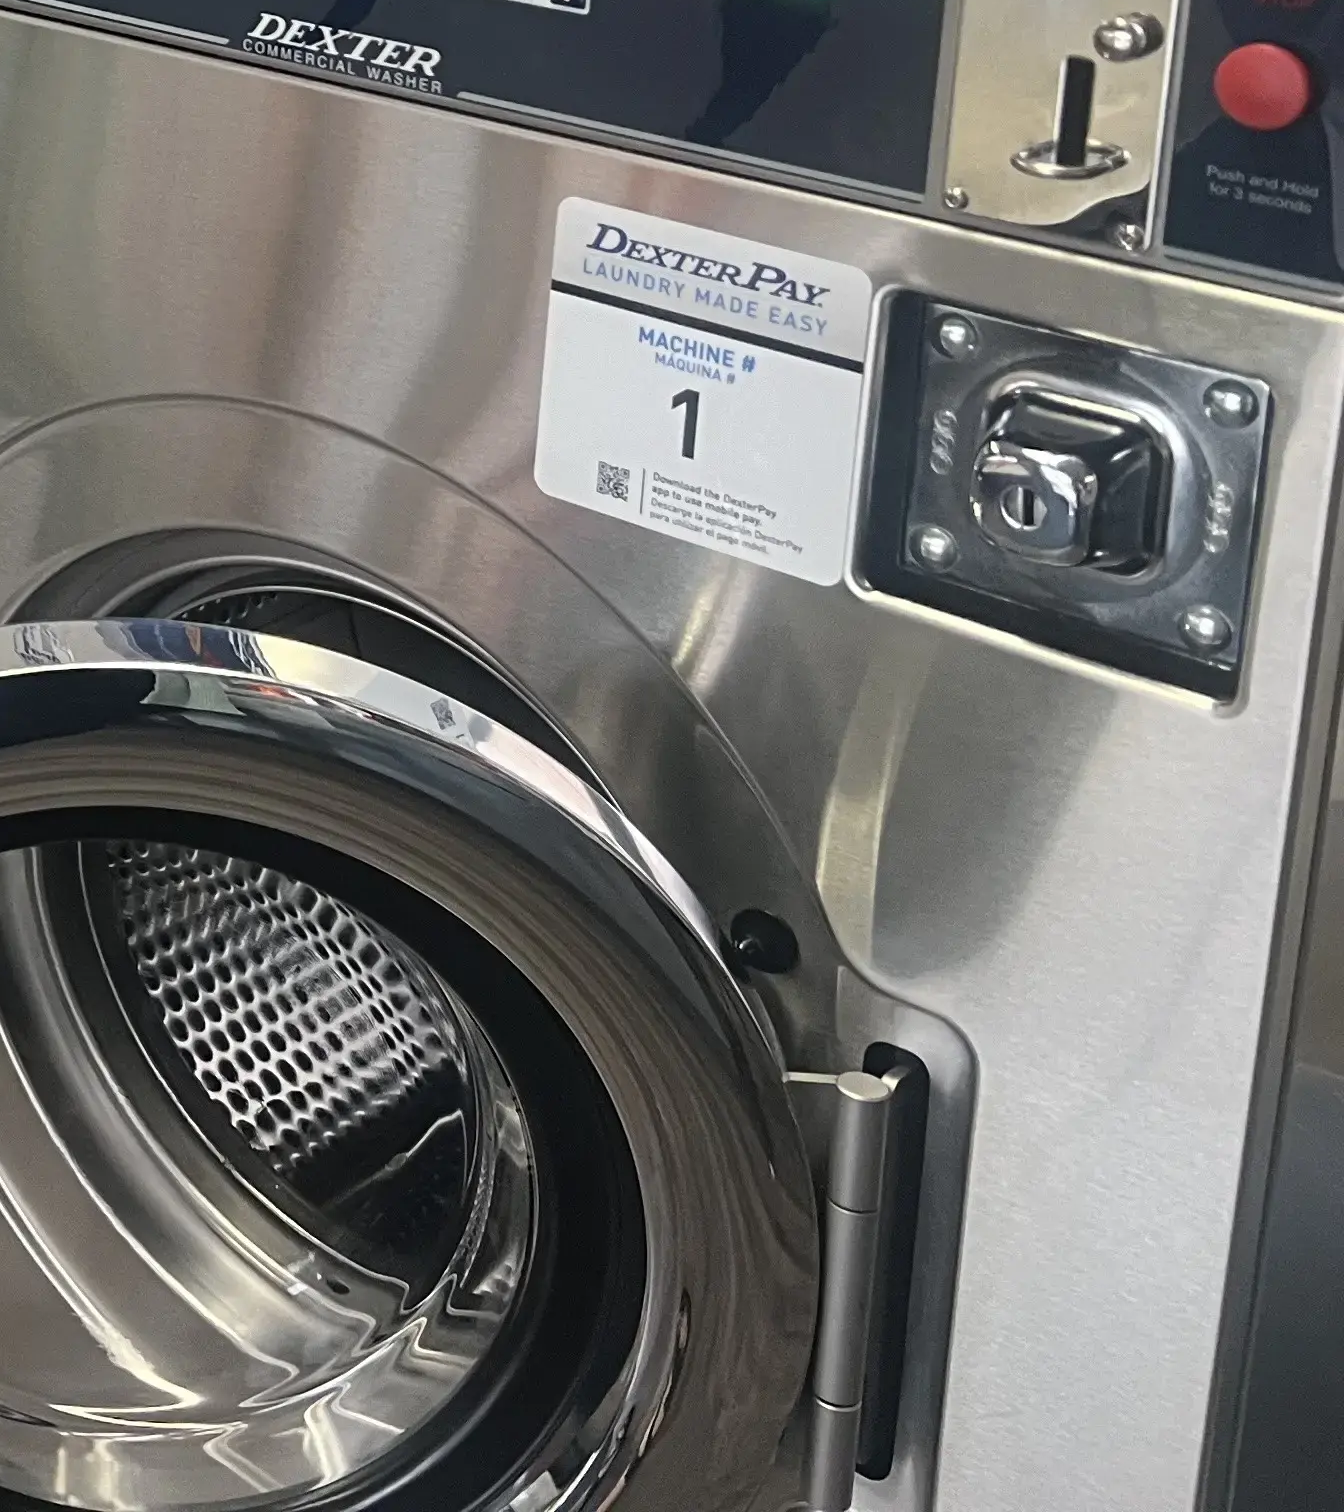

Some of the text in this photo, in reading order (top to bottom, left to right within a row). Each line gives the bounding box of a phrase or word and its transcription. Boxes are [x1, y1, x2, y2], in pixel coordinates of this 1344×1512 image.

[242, 38, 444, 95] COMMERCIAL WASHER
[248, 12, 442, 78] DEXTER
[1206, 164, 1319, 198] Push and Hold
[1209, 182, 1312, 214] for 3 seconds
[585, 223, 830, 308] DEXTERPAY
[583, 258, 828, 337] LAUNDRY MADE EASY
[638, 326, 756, 374] MACHINE #
[671, 387, 701, 460] 1
